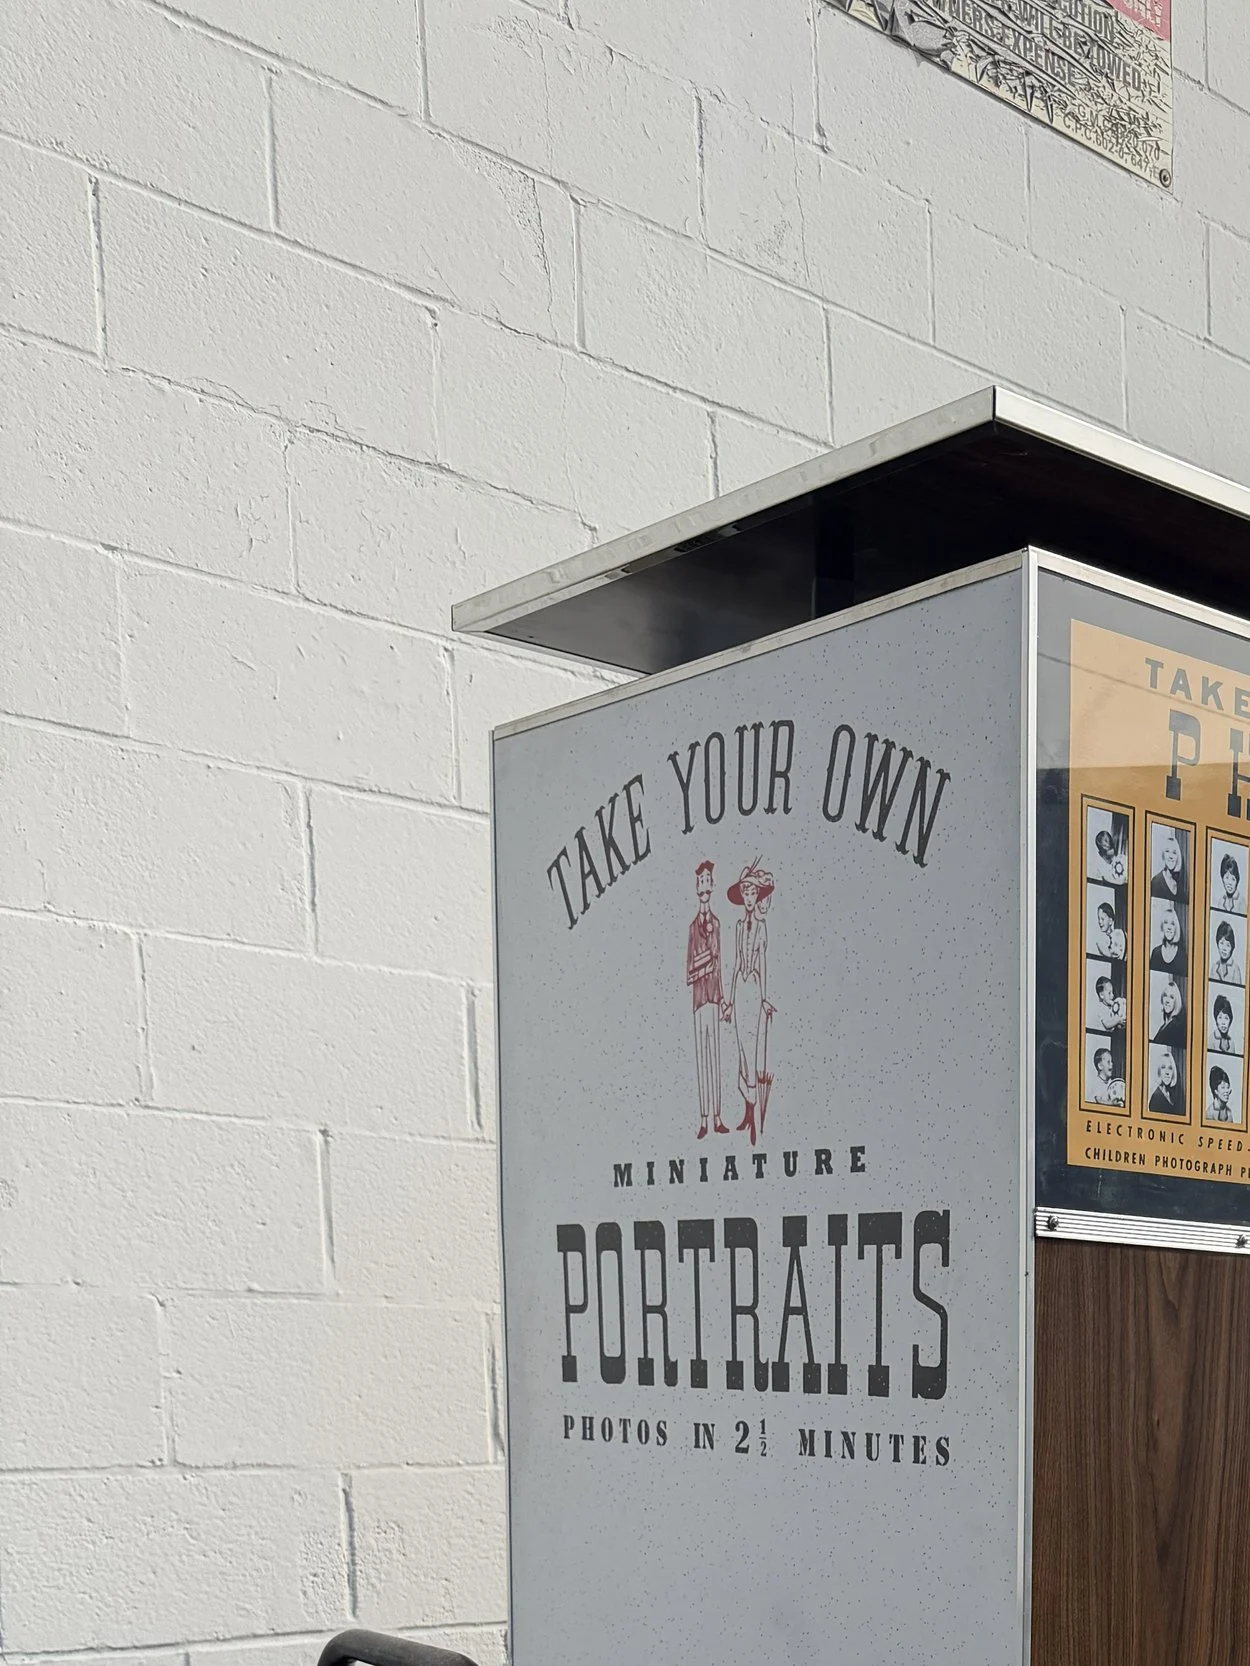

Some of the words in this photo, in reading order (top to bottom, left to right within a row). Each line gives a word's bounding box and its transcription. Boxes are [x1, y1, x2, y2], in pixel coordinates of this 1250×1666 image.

[546, 774, 651, 930] TAKE
[667, 720, 795, 835] YOUR
[822, 724, 951, 868] OWN
[1086, 1120, 1185, 1145] ELECTRONIC
[613, 1145, 866, 1188] MINIATURE
[1085, 1147, 1146, 1166] CHILDREN
[1154, 1155, 1232, 1176] PHOTOGRAPH
[556, 1209, 951, 1400] PORTRAITS
[563, 1415, 668, 1447] PHOTOS
[693, 1422, 715, 1451] IN
[798, 1428, 951, 1467] MINUTES
